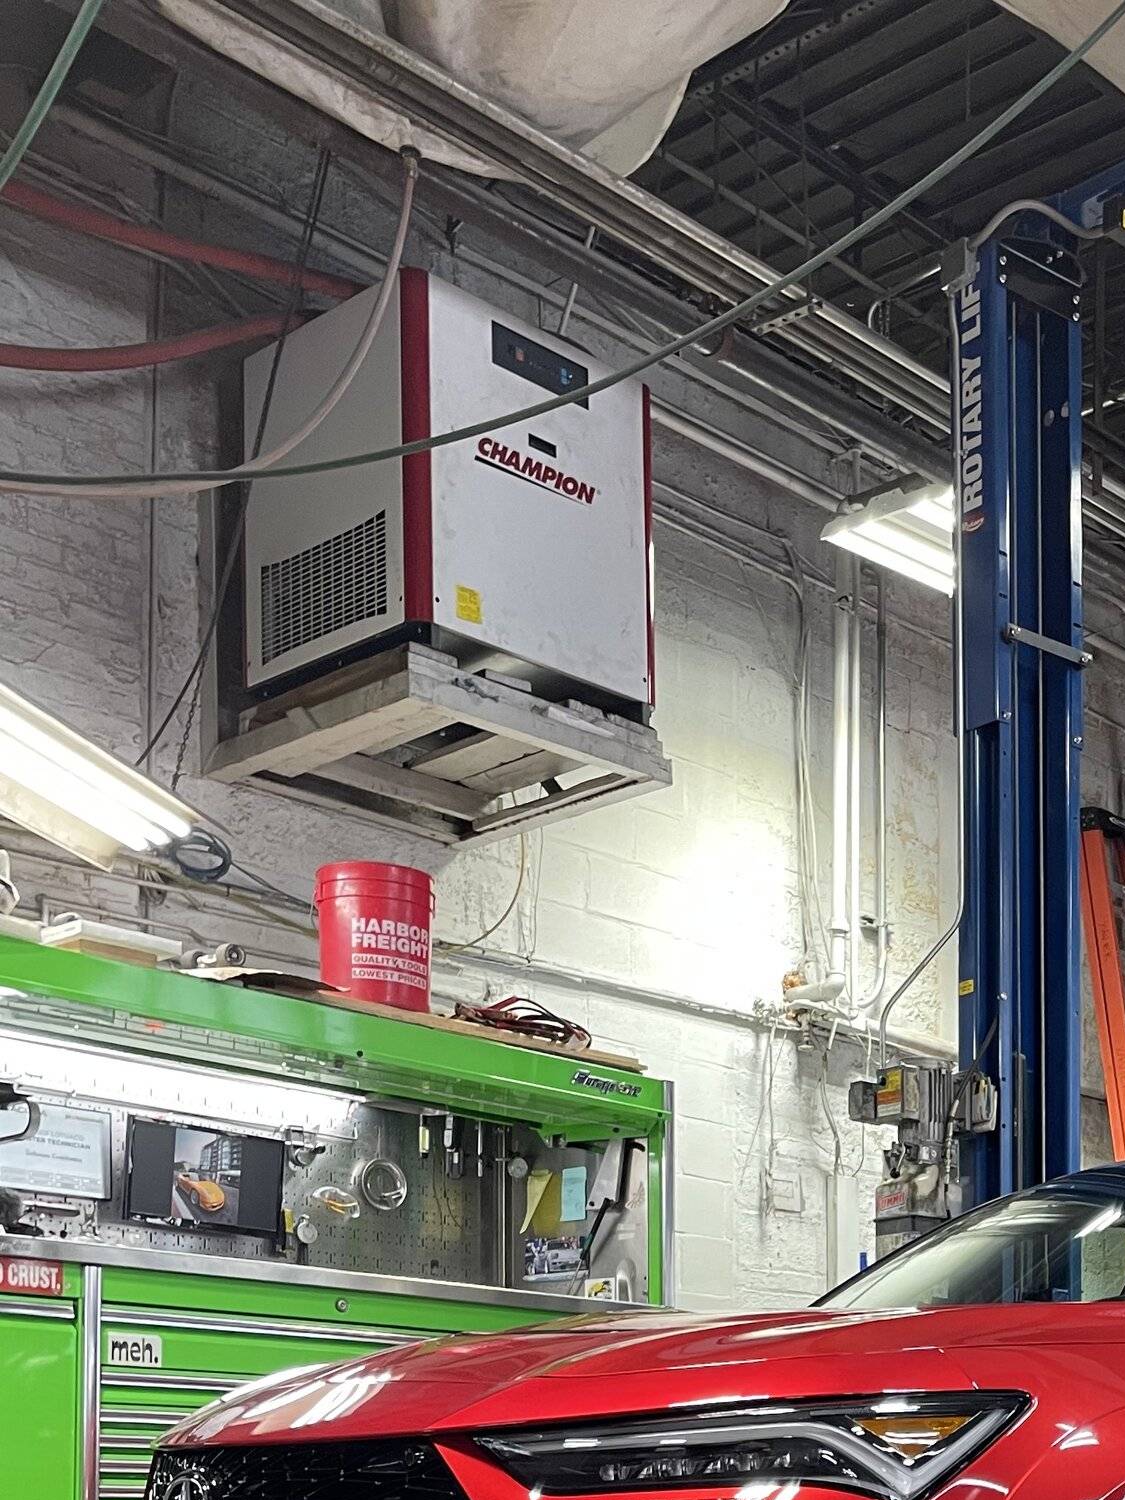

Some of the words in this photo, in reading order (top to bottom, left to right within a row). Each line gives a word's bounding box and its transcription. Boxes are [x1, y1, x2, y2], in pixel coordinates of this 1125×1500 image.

[961, 262, 981, 345] LIF
[962, 356, 983, 514] ROTARY
[478, 437, 595, 504] CHAMPION
[351, 917, 428, 945] HARBOR
[351, 933, 428, 959] FREIGHT
[353, 955, 398, 968] QUALITY
[401, 960, 426, 974] TOOLS
[353, 970, 395, 980] LOWEST
[397, 974, 425, 988] PRICES
[8, 1262, 61, 1289] CRUST.
[111, 1338, 159, 1364] meh.
